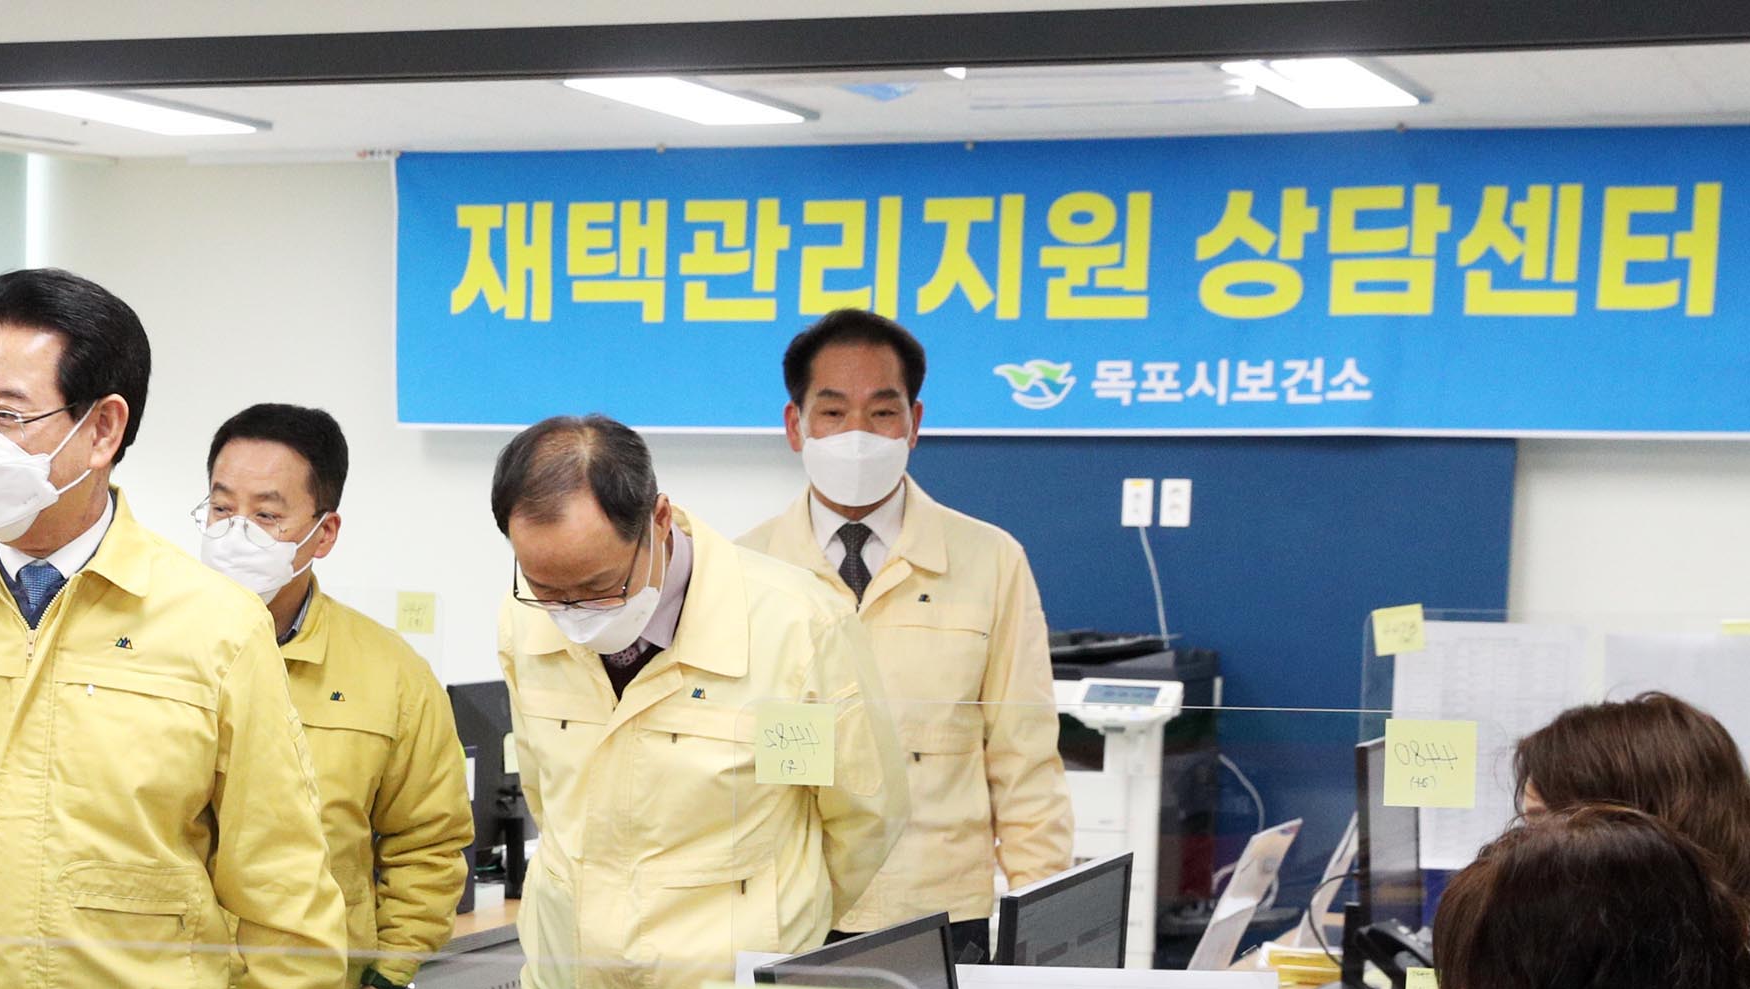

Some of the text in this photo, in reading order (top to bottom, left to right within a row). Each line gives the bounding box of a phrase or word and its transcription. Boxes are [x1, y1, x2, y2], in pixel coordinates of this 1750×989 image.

[450, 181, 1722, 323] 재택관리지원 상담센터
[1090, 357, 1373, 405] 목포시보건소
